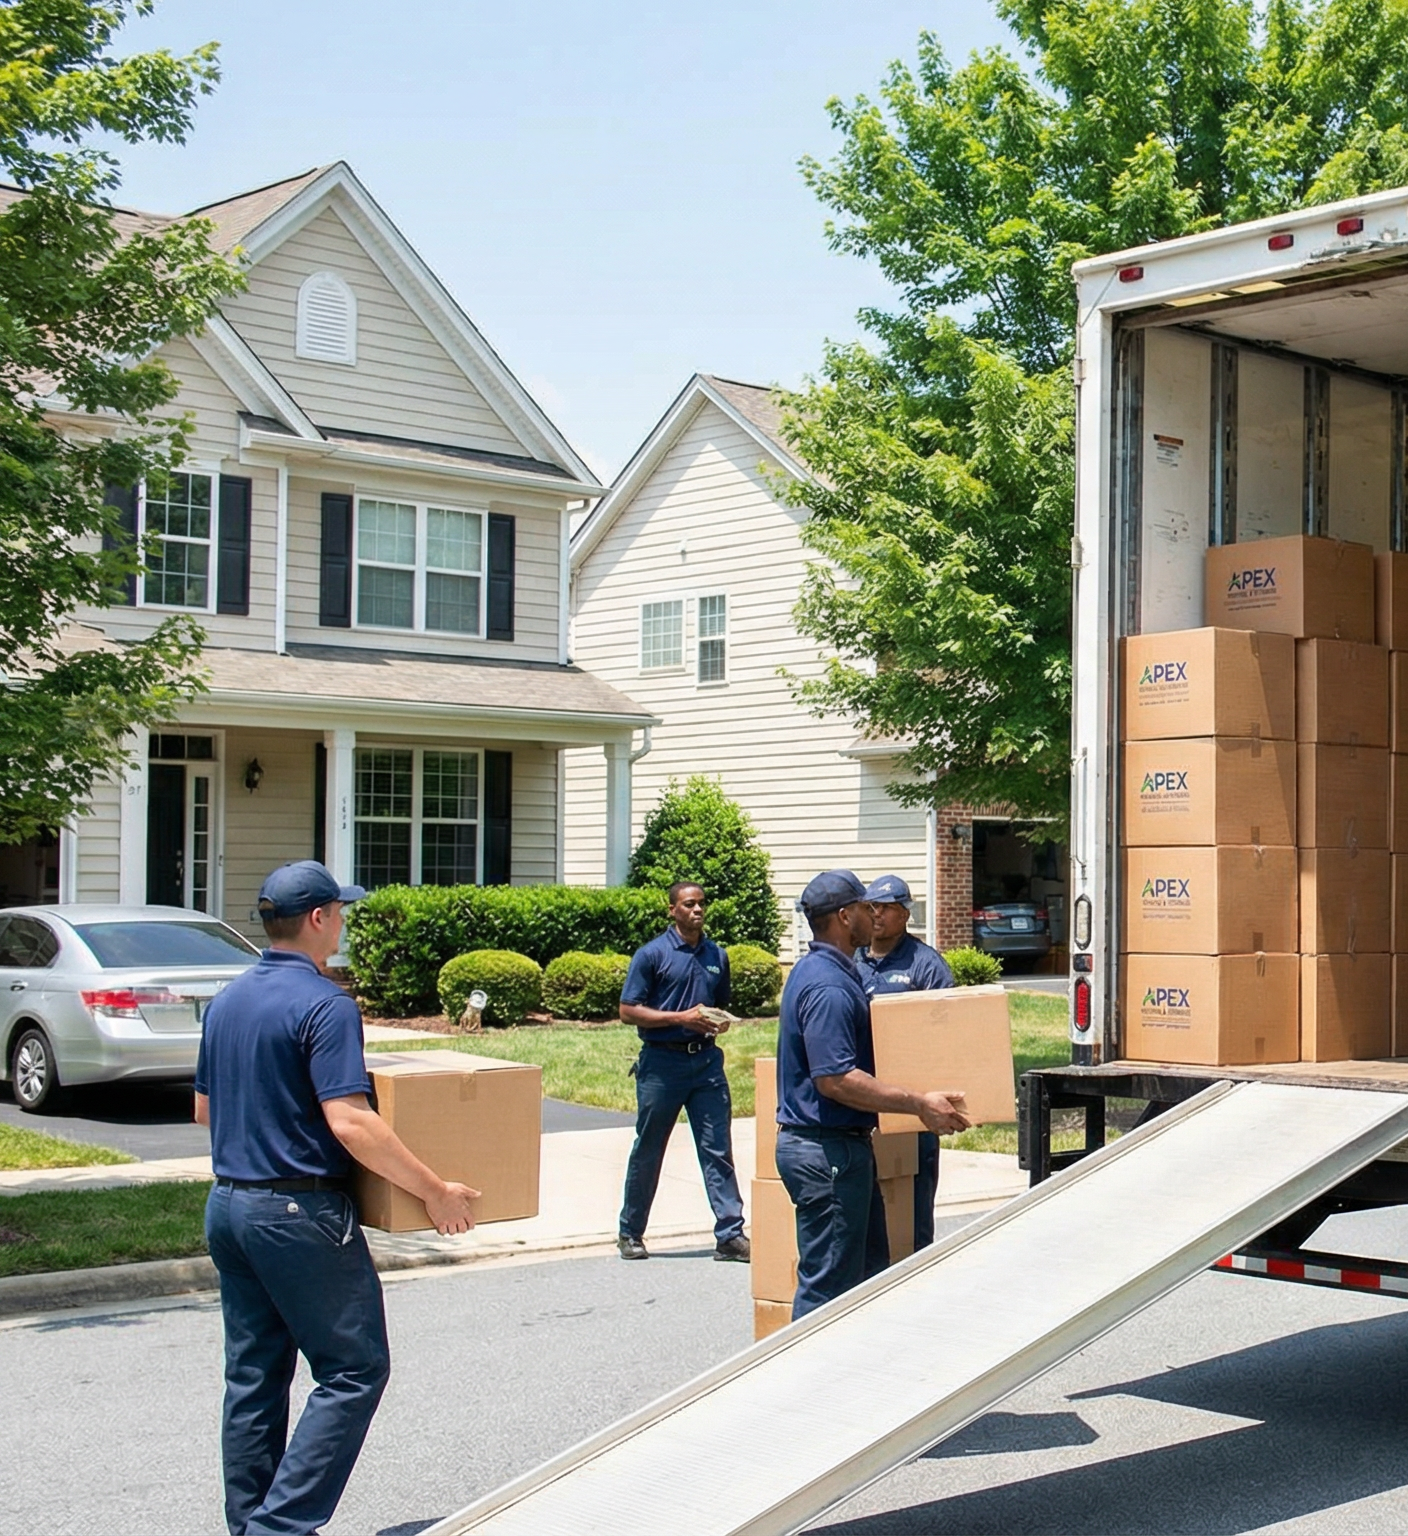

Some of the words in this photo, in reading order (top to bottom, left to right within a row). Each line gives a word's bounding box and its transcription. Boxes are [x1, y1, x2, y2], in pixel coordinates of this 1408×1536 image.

[1228, 567, 1276, 591] APEX
[1139, 661, 1187, 685] APEX
[1140, 771, 1188, 792] APEX
[1141, 878, 1190, 898] APEX
[1142, 987, 1190, 1007] APEX
